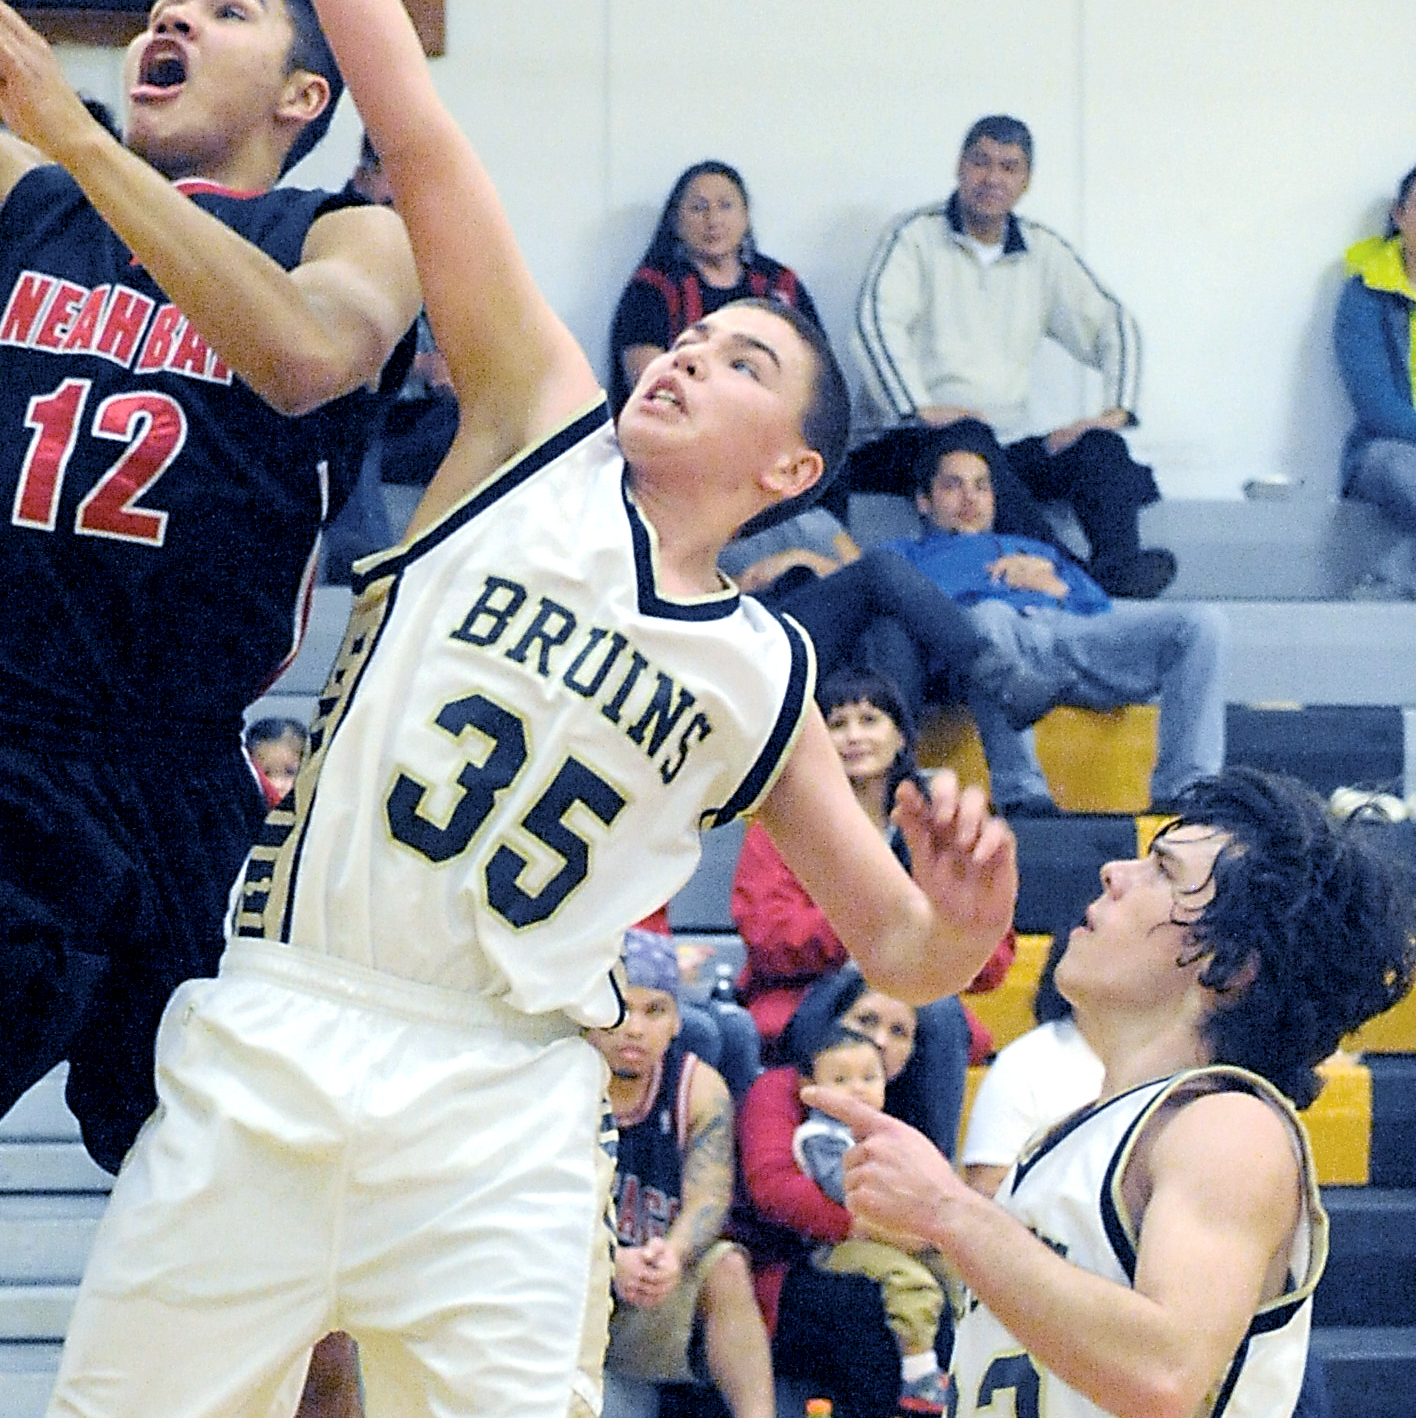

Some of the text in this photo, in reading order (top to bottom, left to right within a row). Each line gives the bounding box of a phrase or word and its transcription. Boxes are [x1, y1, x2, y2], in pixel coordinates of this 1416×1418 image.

[133, 301, 233, 386] BA
[11, 377, 188, 547] 12
[450, 574, 712, 786] BRUINS
[385, 690, 629, 932] 35
